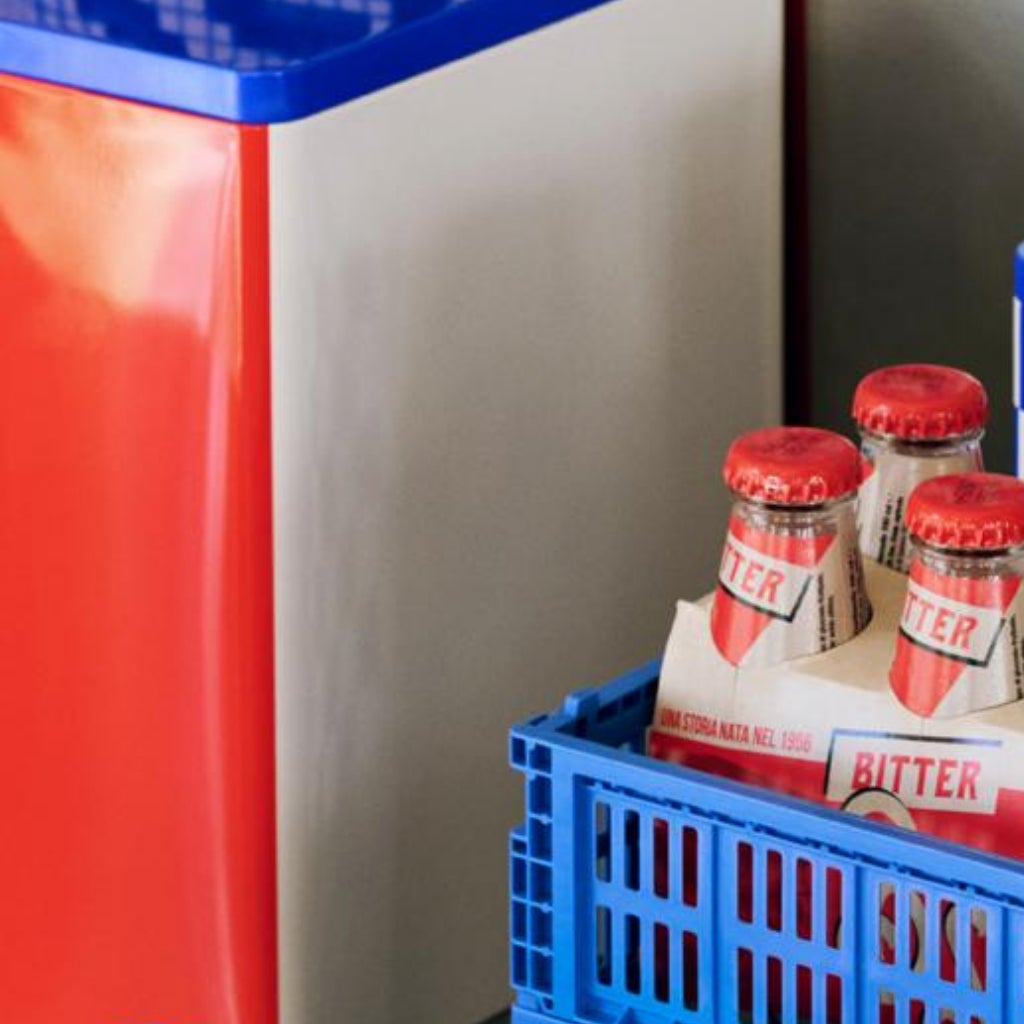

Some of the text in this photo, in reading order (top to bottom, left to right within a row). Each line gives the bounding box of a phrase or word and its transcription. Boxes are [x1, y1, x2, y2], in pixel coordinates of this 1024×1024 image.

[661, 707, 682, 728] UNA
[683, 711, 717, 737] STORIA
[719, 721, 749, 744] NATA
[752, 723, 776, 748] NEL
[851, 751, 982, 800] BITTER
